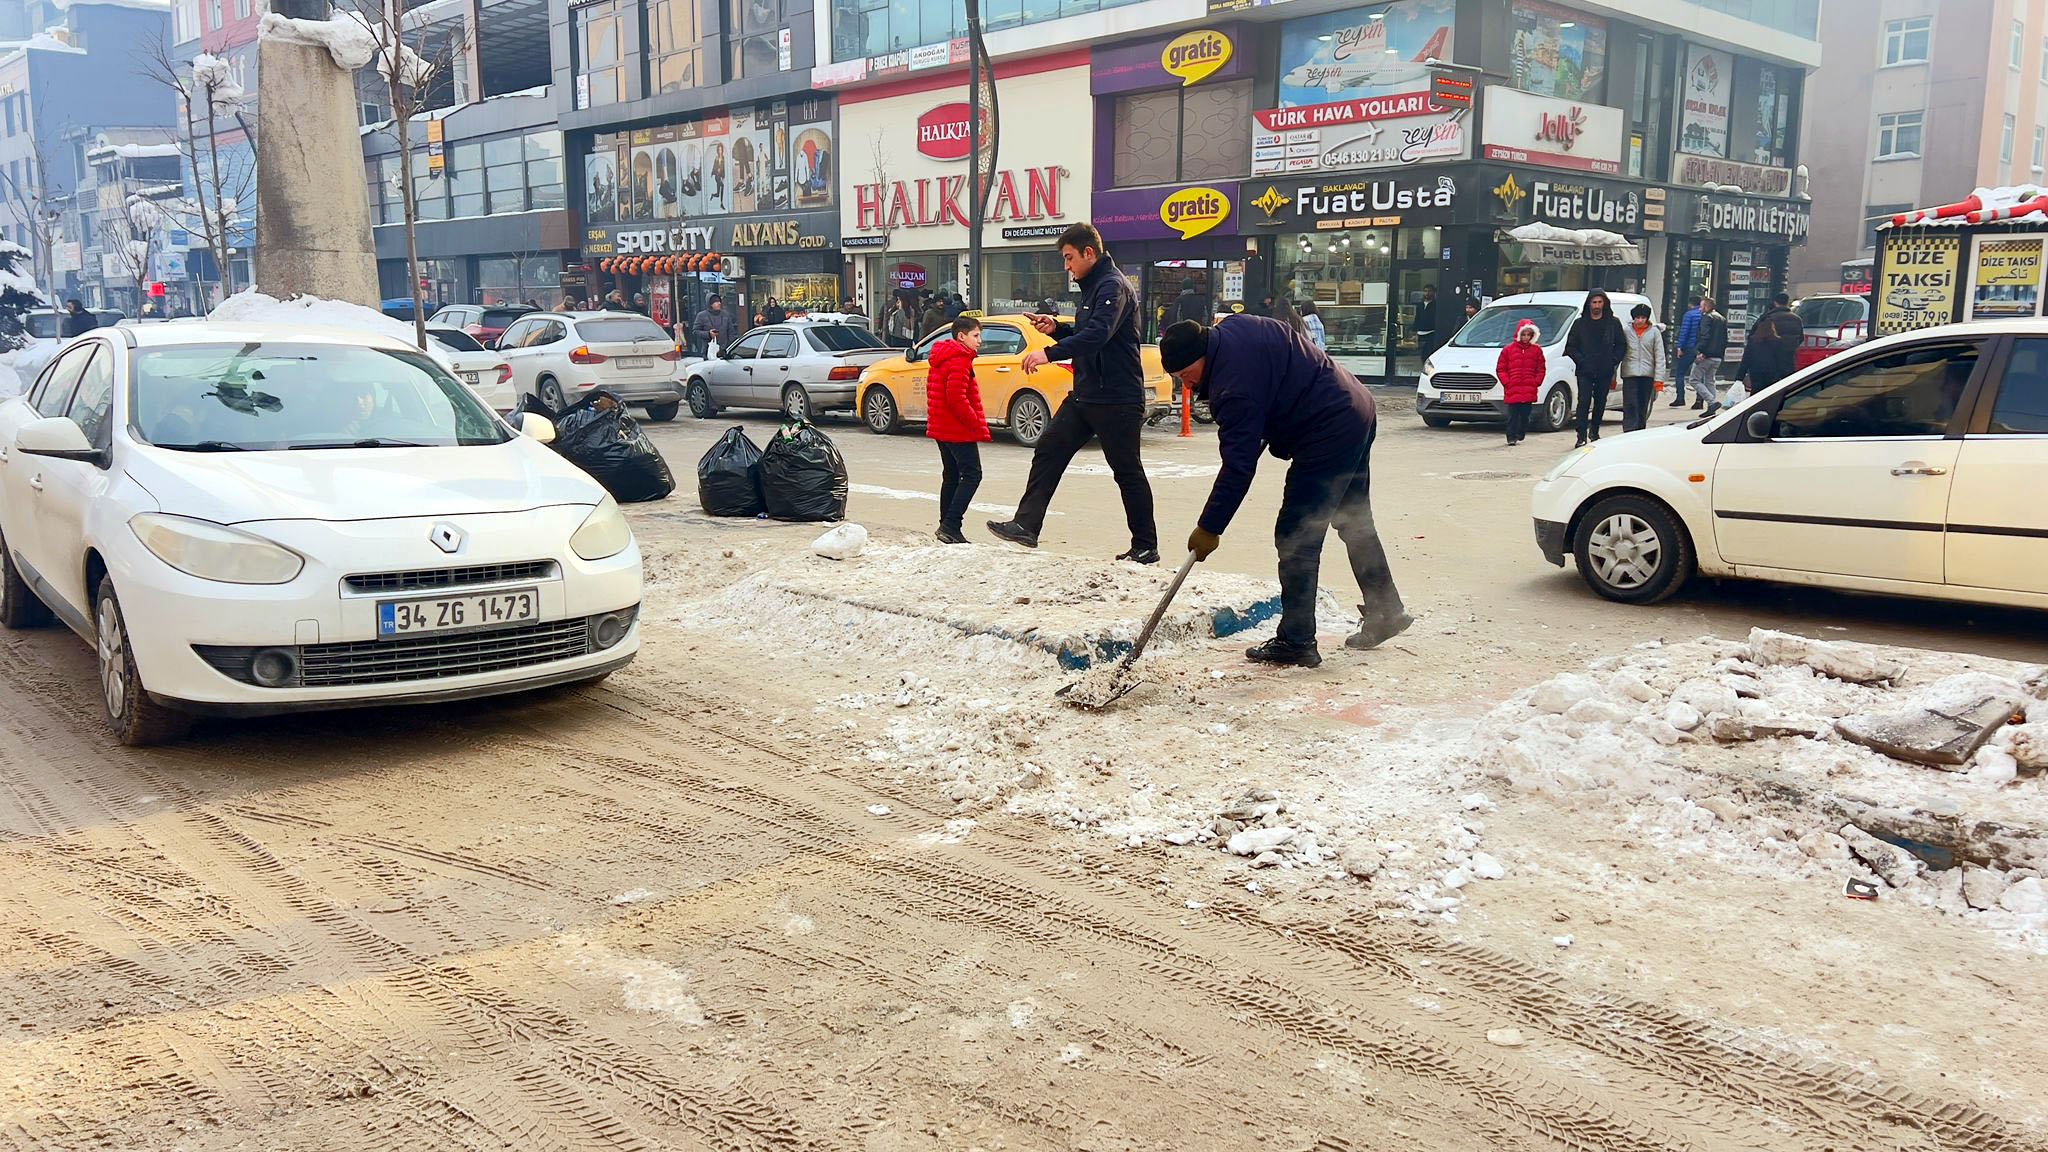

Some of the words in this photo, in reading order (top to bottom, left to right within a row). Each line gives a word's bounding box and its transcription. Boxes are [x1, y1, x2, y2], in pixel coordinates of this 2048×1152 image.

[1169, 35, 1222, 69] gratis
[803, 101, 818, 120] GAP
[1269, 111, 1306, 127] TÜRK
[1313, 105, 1353, 122] HAVA
[1360, 96, 1423, 117] YOLLARI
[920, 121, 982, 143] HALKTA
[1535, 112, 1575, 151] Jolly
[1325, 151, 1349, 165] 0546
[1352, 149, 1367, 162] 830
[1369, 149, 1382, 160] 21
[1322, 182, 1365, 193] BAKLAVACI
[1167, 193, 1220, 223] gratis
[1296, 187, 1366, 216] Fuat
[1372, 181, 1451, 211] Usta
[1532, 181, 1583, 219] Fuat
[1587, 188, 1637, 224] Usta
[1712, 198, 1756, 232] DEMİR
[1758, 200, 1810, 243] İLETİŞİM
[616, 229, 667, 254] SPOR
[731, 220, 799, 247] ALYANS
[798, 235, 826, 249] GOLD
[1543, 246, 1582, 260] Fuat
[1583, 249, 1623, 262] Usta
[1896, 249, 1945, 265] DİZE
[1981, 256, 2004, 267] DİZE
[2007, 254, 2038, 267] TAKSİ
[889, 271, 925, 281] HALKTAN
[1887, 269, 1951, 287] TAKSİ
[1902, 311, 1919, 322] 351
[1922, 311, 1935, 322] 79
[1937, 311, 1949, 321] 19
[466, 373, 478, 381] 123
[397, 604, 427, 630] 34
[436, 601, 464, 627] ZG
[478, 594, 531, 622] 1473
[383, 621, 394, 629] TR
